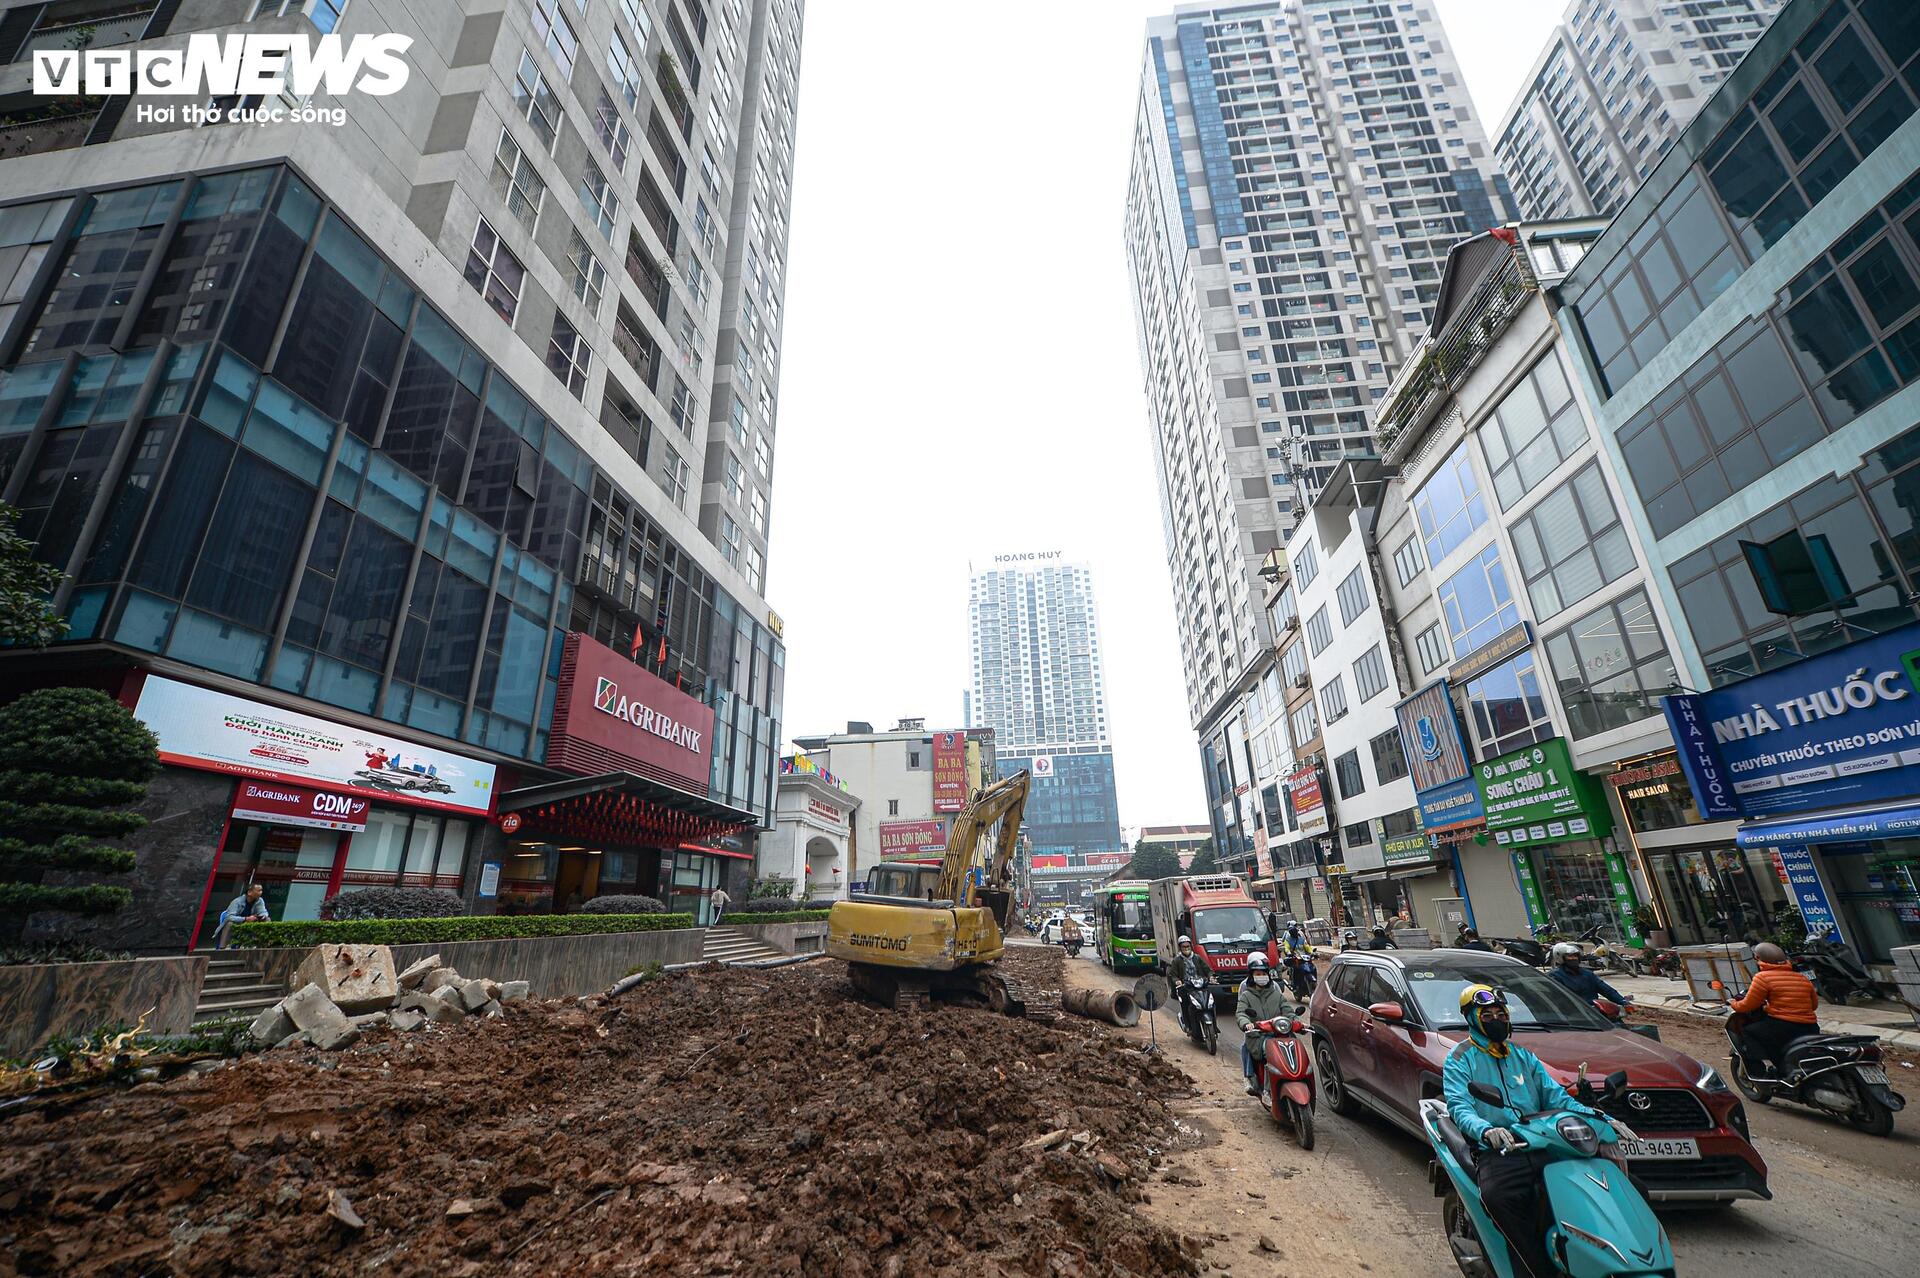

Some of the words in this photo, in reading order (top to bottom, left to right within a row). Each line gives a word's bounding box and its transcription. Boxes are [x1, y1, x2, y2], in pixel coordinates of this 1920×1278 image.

[1711, 704, 1782, 745] NHÀ
[1776, 667, 1908, 727] THUỐC
[224, 715, 261, 729] KHỞI
[266, 725, 305, 739] HÀNH
[308, 736, 344, 748] XANH
[615, 696, 702, 753] AGRIBANK
[225, 722, 259, 734] Đồng
[261, 730, 290, 741] hành
[293, 737, 320, 748] cùng
[321, 744, 341, 753] bạn
[1679, 699, 1702, 737] NHÀ
[1694, 742, 1727, 806] THUỐC
[1731, 753, 1777, 773] CHUYÊN
[1779, 742, 1825, 767] THUỐC
[1824, 735, 1865, 755] THEO
[1867, 724, 1904, 746] ĐƠN
[951, 757, 962, 768] BA
[1494, 762, 1509, 776] NHÀ
[1508, 753, 1532, 772] THUỐC
[227, 765, 279, 778] AGRIBANK
[1486, 780, 1515, 800] SONG
[1513, 771, 1546, 793] CHÂU
[1546, 769, 1559, 785] 1
[1628, 787, 1647, 799] HAIR
[1646, 783, 1669, 795] SALON
[255, 789, 301, 803] AGRIBANK
[312, 793, 353, 815] CDM
[504, 817, 518, 827] ria
[882, 834, 892, 847] BA
[892, 833, 902, 846] BA
[1744, 835, 1766, 844] GIAO
[1766, 832, 1792, 842] HÀNG
[1793, 832, 1807, 841] TẠI
[1808, 828, 1830, 838] NHÀ
[1830, 824, 1857, 836] MIỄN
[1859, 822, 1878, 834] PHÍ
[1782, 849, 1809, 860] THUỐC
[1787, 861, 1813, 871] CHÍNH
[296, 870, 331, 880] AGRIBANK
[1803, 893, 1818, 902] GIÁ
[1805, 905, 1828, 914] LUÔN
[1808, 917, 1834, 934] TỐT
[850, 933, 907, 951] SUMITOMO
[1216, 958, 1238, 967] HOA
[1619, 1141, 1692, 1156] 30L-949.25
